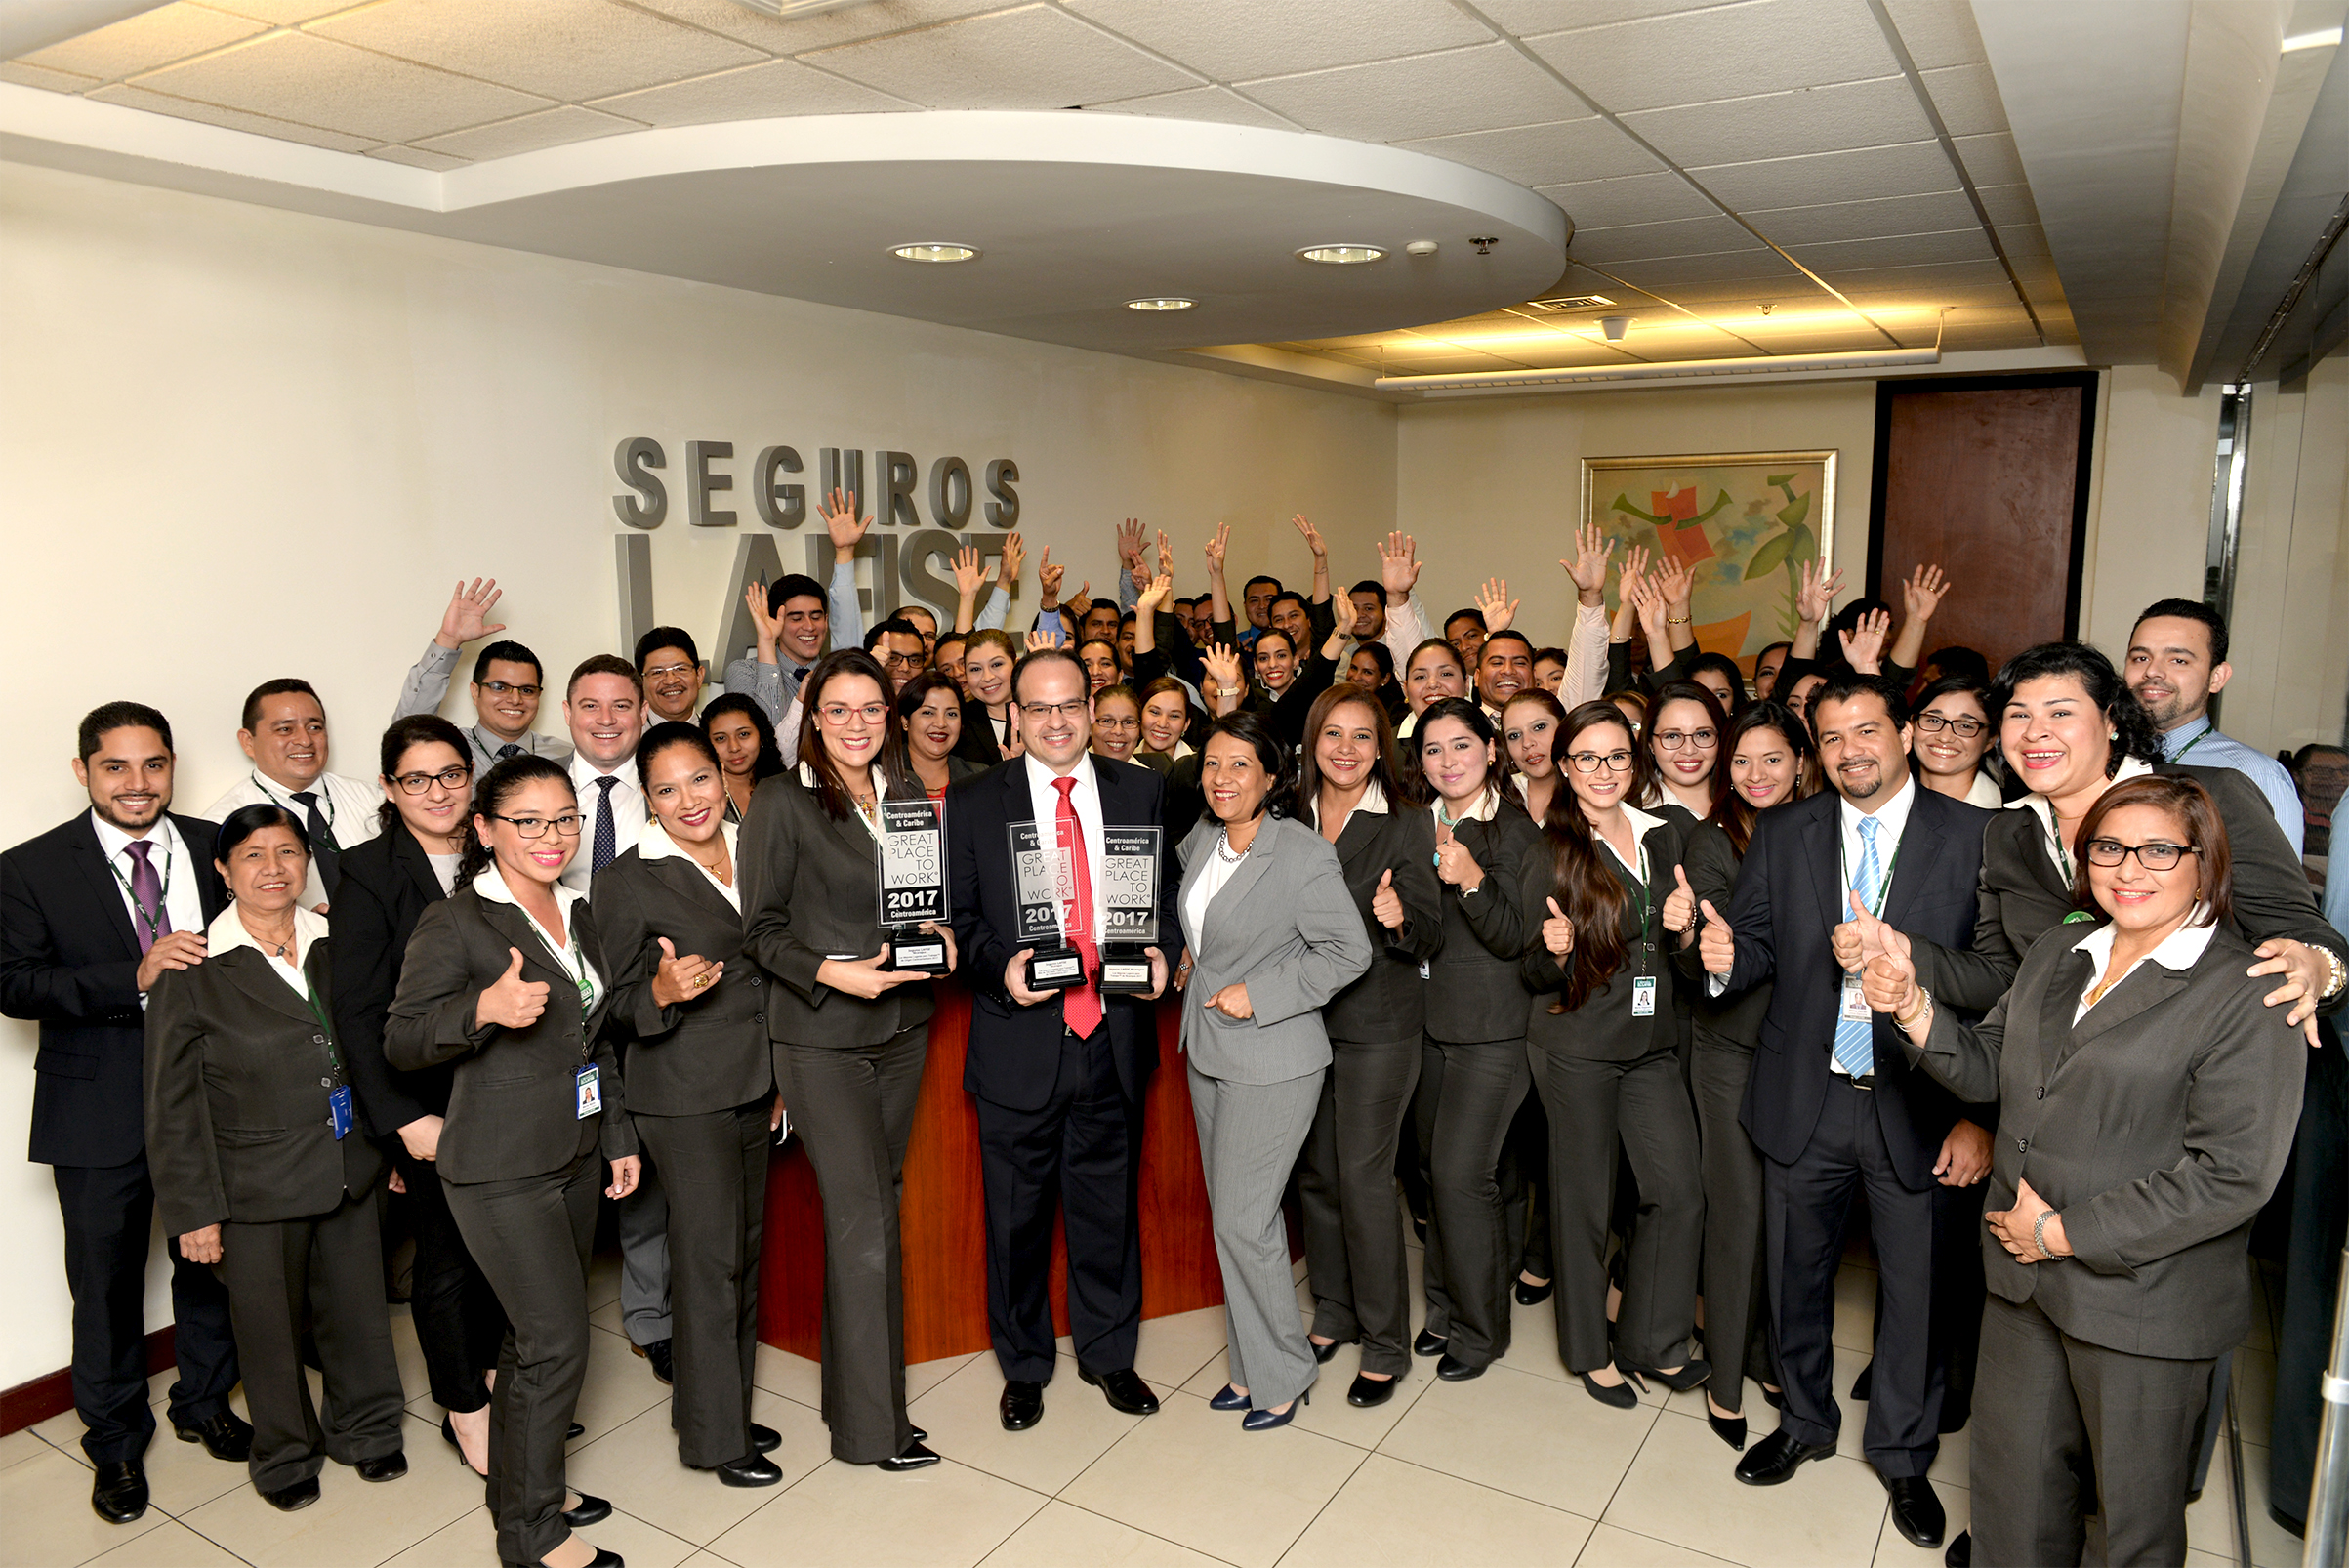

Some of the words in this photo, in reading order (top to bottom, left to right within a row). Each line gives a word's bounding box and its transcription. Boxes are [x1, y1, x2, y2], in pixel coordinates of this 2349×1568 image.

[612, 436, 1020, 529] SEGUROS
[887, 833, 933, 846] GREAT
[1020, 830, 1064, 840] Centroamérca
[888, 846, 934, 859] PLACE
[916, 859, 934, 871] TO
[1105, 858, 1148, 869] GREAT
[1105, 871, 1148, 882] PLACE
[1130, 883, 1147, 892] TO
[887, 890, 938, 909] 2017
[1101, 911, 1148, 926] 2017
[1028, 922, 1072, 931] Centroamérca
